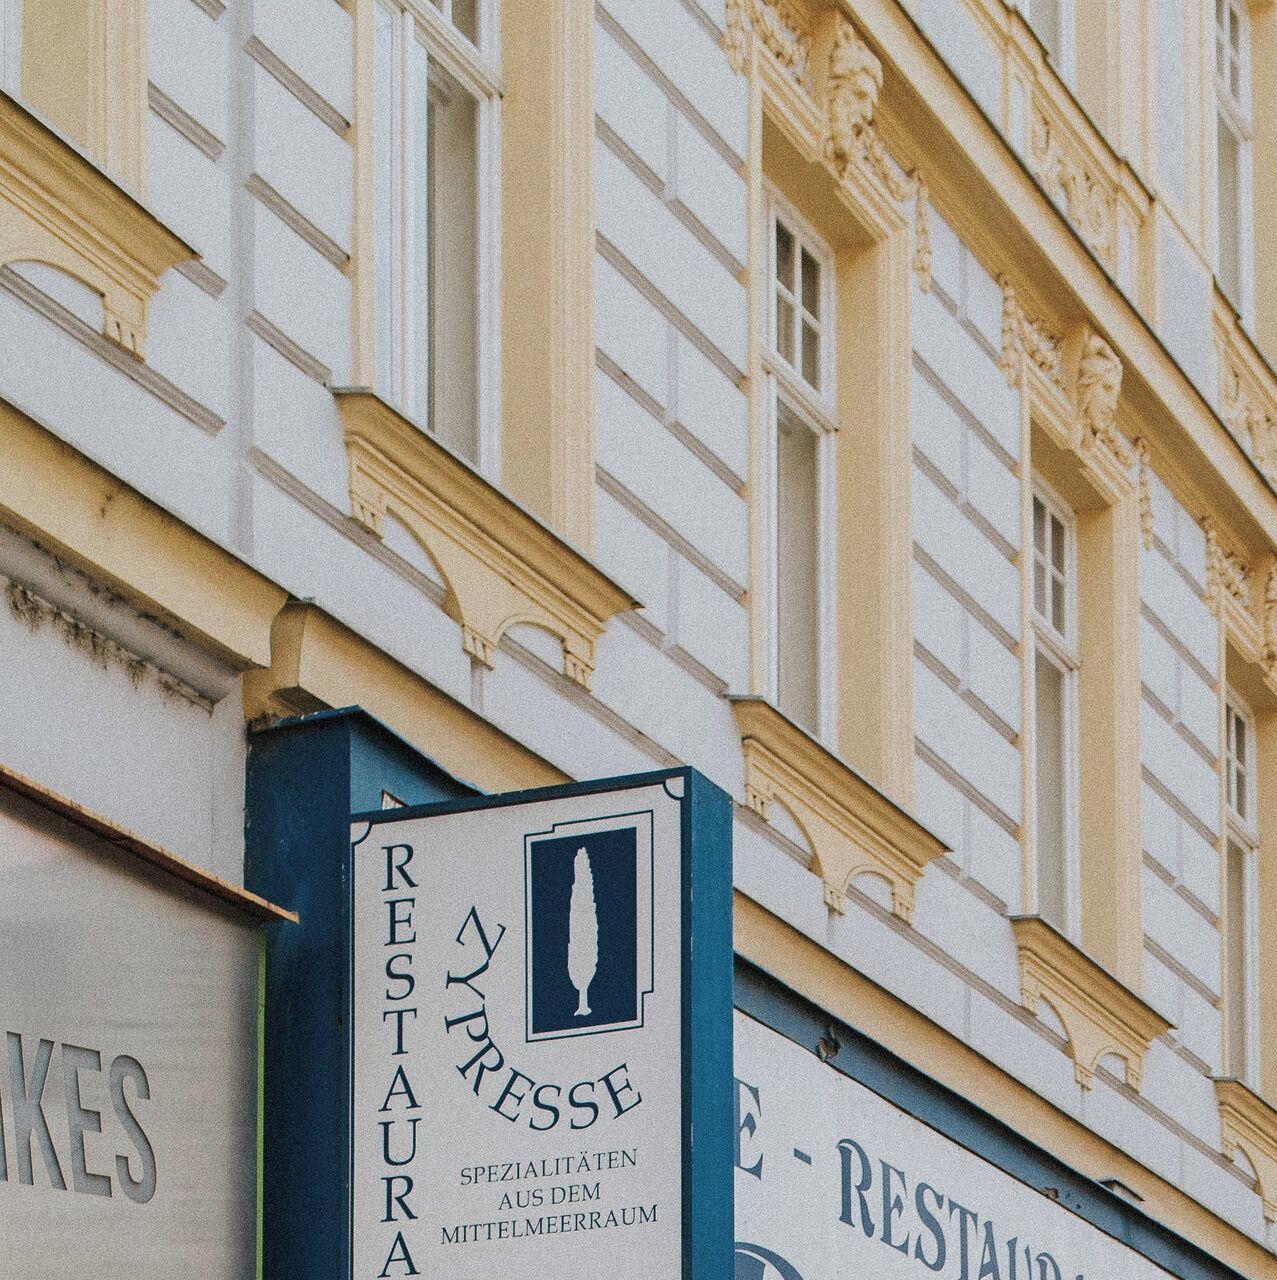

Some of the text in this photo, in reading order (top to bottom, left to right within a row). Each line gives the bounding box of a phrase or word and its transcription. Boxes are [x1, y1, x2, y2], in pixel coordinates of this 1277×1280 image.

[444, 904, 643, 1132] ZYPRESSE
[0, 1031, 157, 1204] KES
[460, 1149, 637, 1186] SPEZIALITÄTEN
[498, 1182, 601, 1211] AUS DEM
[440, 1204, 658, 1245] MITTELMEERRAUM
